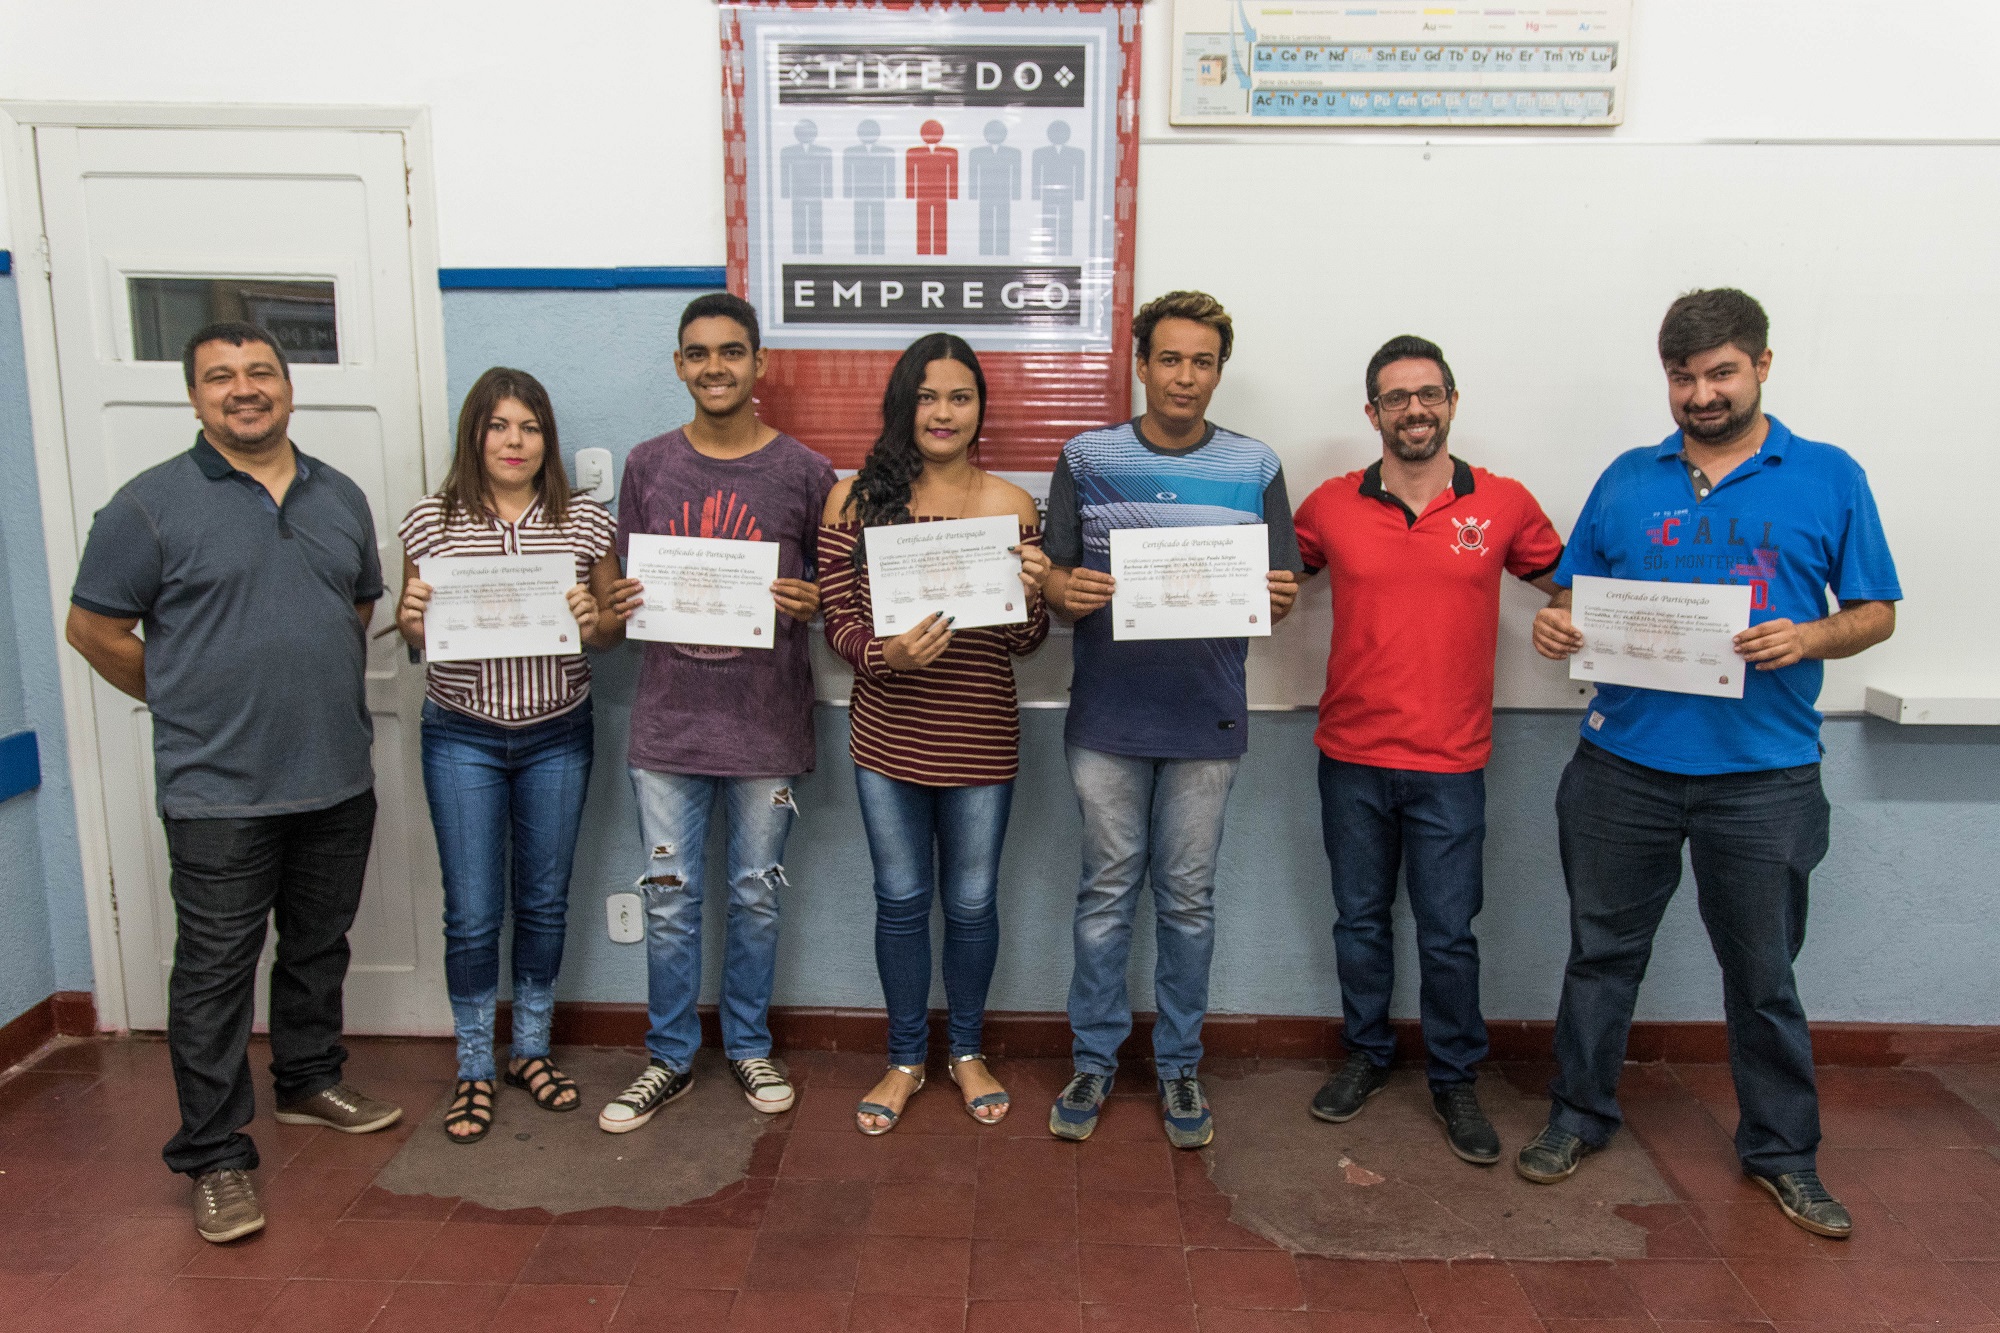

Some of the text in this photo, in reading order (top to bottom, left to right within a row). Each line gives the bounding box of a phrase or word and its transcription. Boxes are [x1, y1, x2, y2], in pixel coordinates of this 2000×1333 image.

[1422, 22, 1436, 31] Au
[1525, 21, 1540, 32] Hg
[1257, 51, 1272, 60] La
[1281, 51, 1297, 61] Ce
[1305, 51, 1318, 60] Pr
[1329, 51, 1345, 61] Nd
[1376, 51, 1396, 61] Sm
[1401, 51, 1417, 61] Eu
[1424, 51, 1441, 61] Gd
[1448, 51, 1464, 61] Tb
[1472, 51, 1488, 63] Dy
[1496, 51, 1512, 61] Ho
[1520, 51, 1533, 61] Er
[1544, 51, 1562, 61] Tm
[1569, 51, 1584, 61] Yb
[819, 60, 1043, 92] TIME DO
[1255, 95, 1272, 106] Ac
[1279, 95, 1295, 106] Th
[1303, 95, 1318, 106] Pa
[1326, 95, 1336, 106] U
[1349, 95, 1368, 109] Np
[1373, 95, 1391, 107] Pu
[793, 279, 1072, 310] EMPREGO
[897, 530, 986, 545] Certificado de Participação
[1142, 538, 1234, 549] Certificado de Participação
[658, 547, 746, 560] Certificado de Participação
[1605, 590, 1648, 601] Certificado
[1660, 595, 1710, 606] Participação
